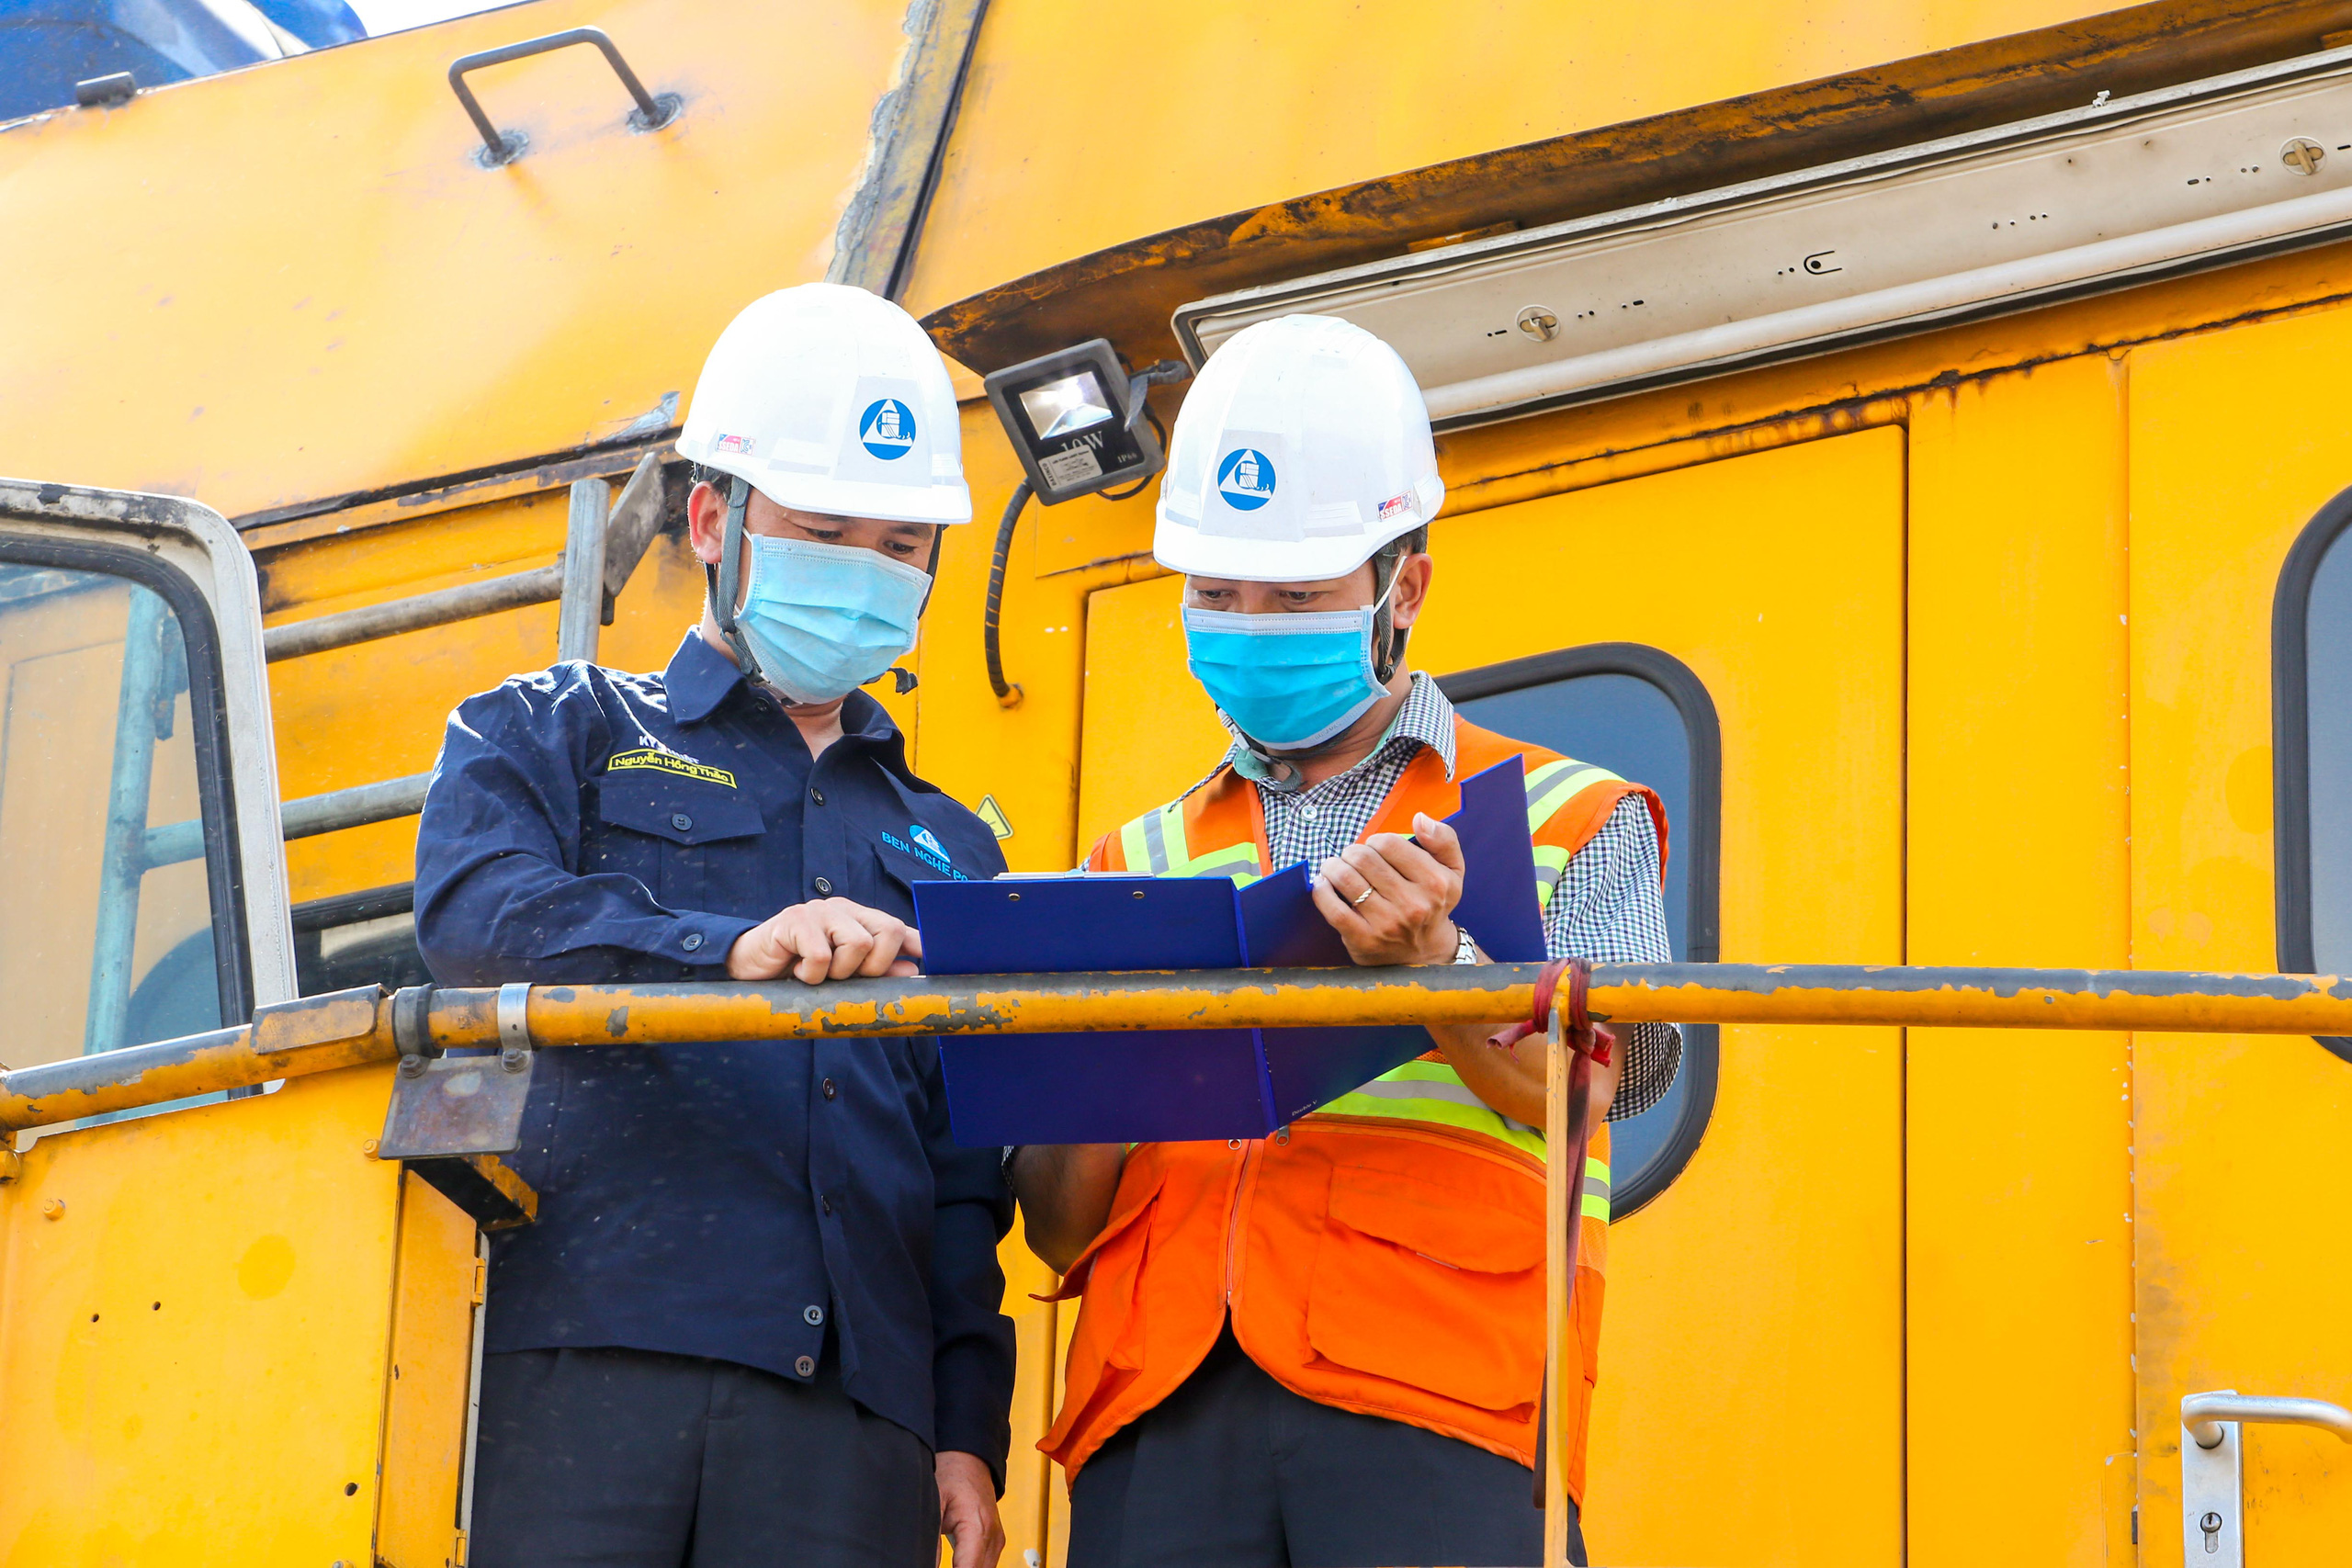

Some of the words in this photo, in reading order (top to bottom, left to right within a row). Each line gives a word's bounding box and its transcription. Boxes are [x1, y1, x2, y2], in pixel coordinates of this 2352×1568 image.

[615, 751, 662, 767] Nguyễn
[882, 831, 910, 853] BEN
[914, 847, 951, 876] NGHE
